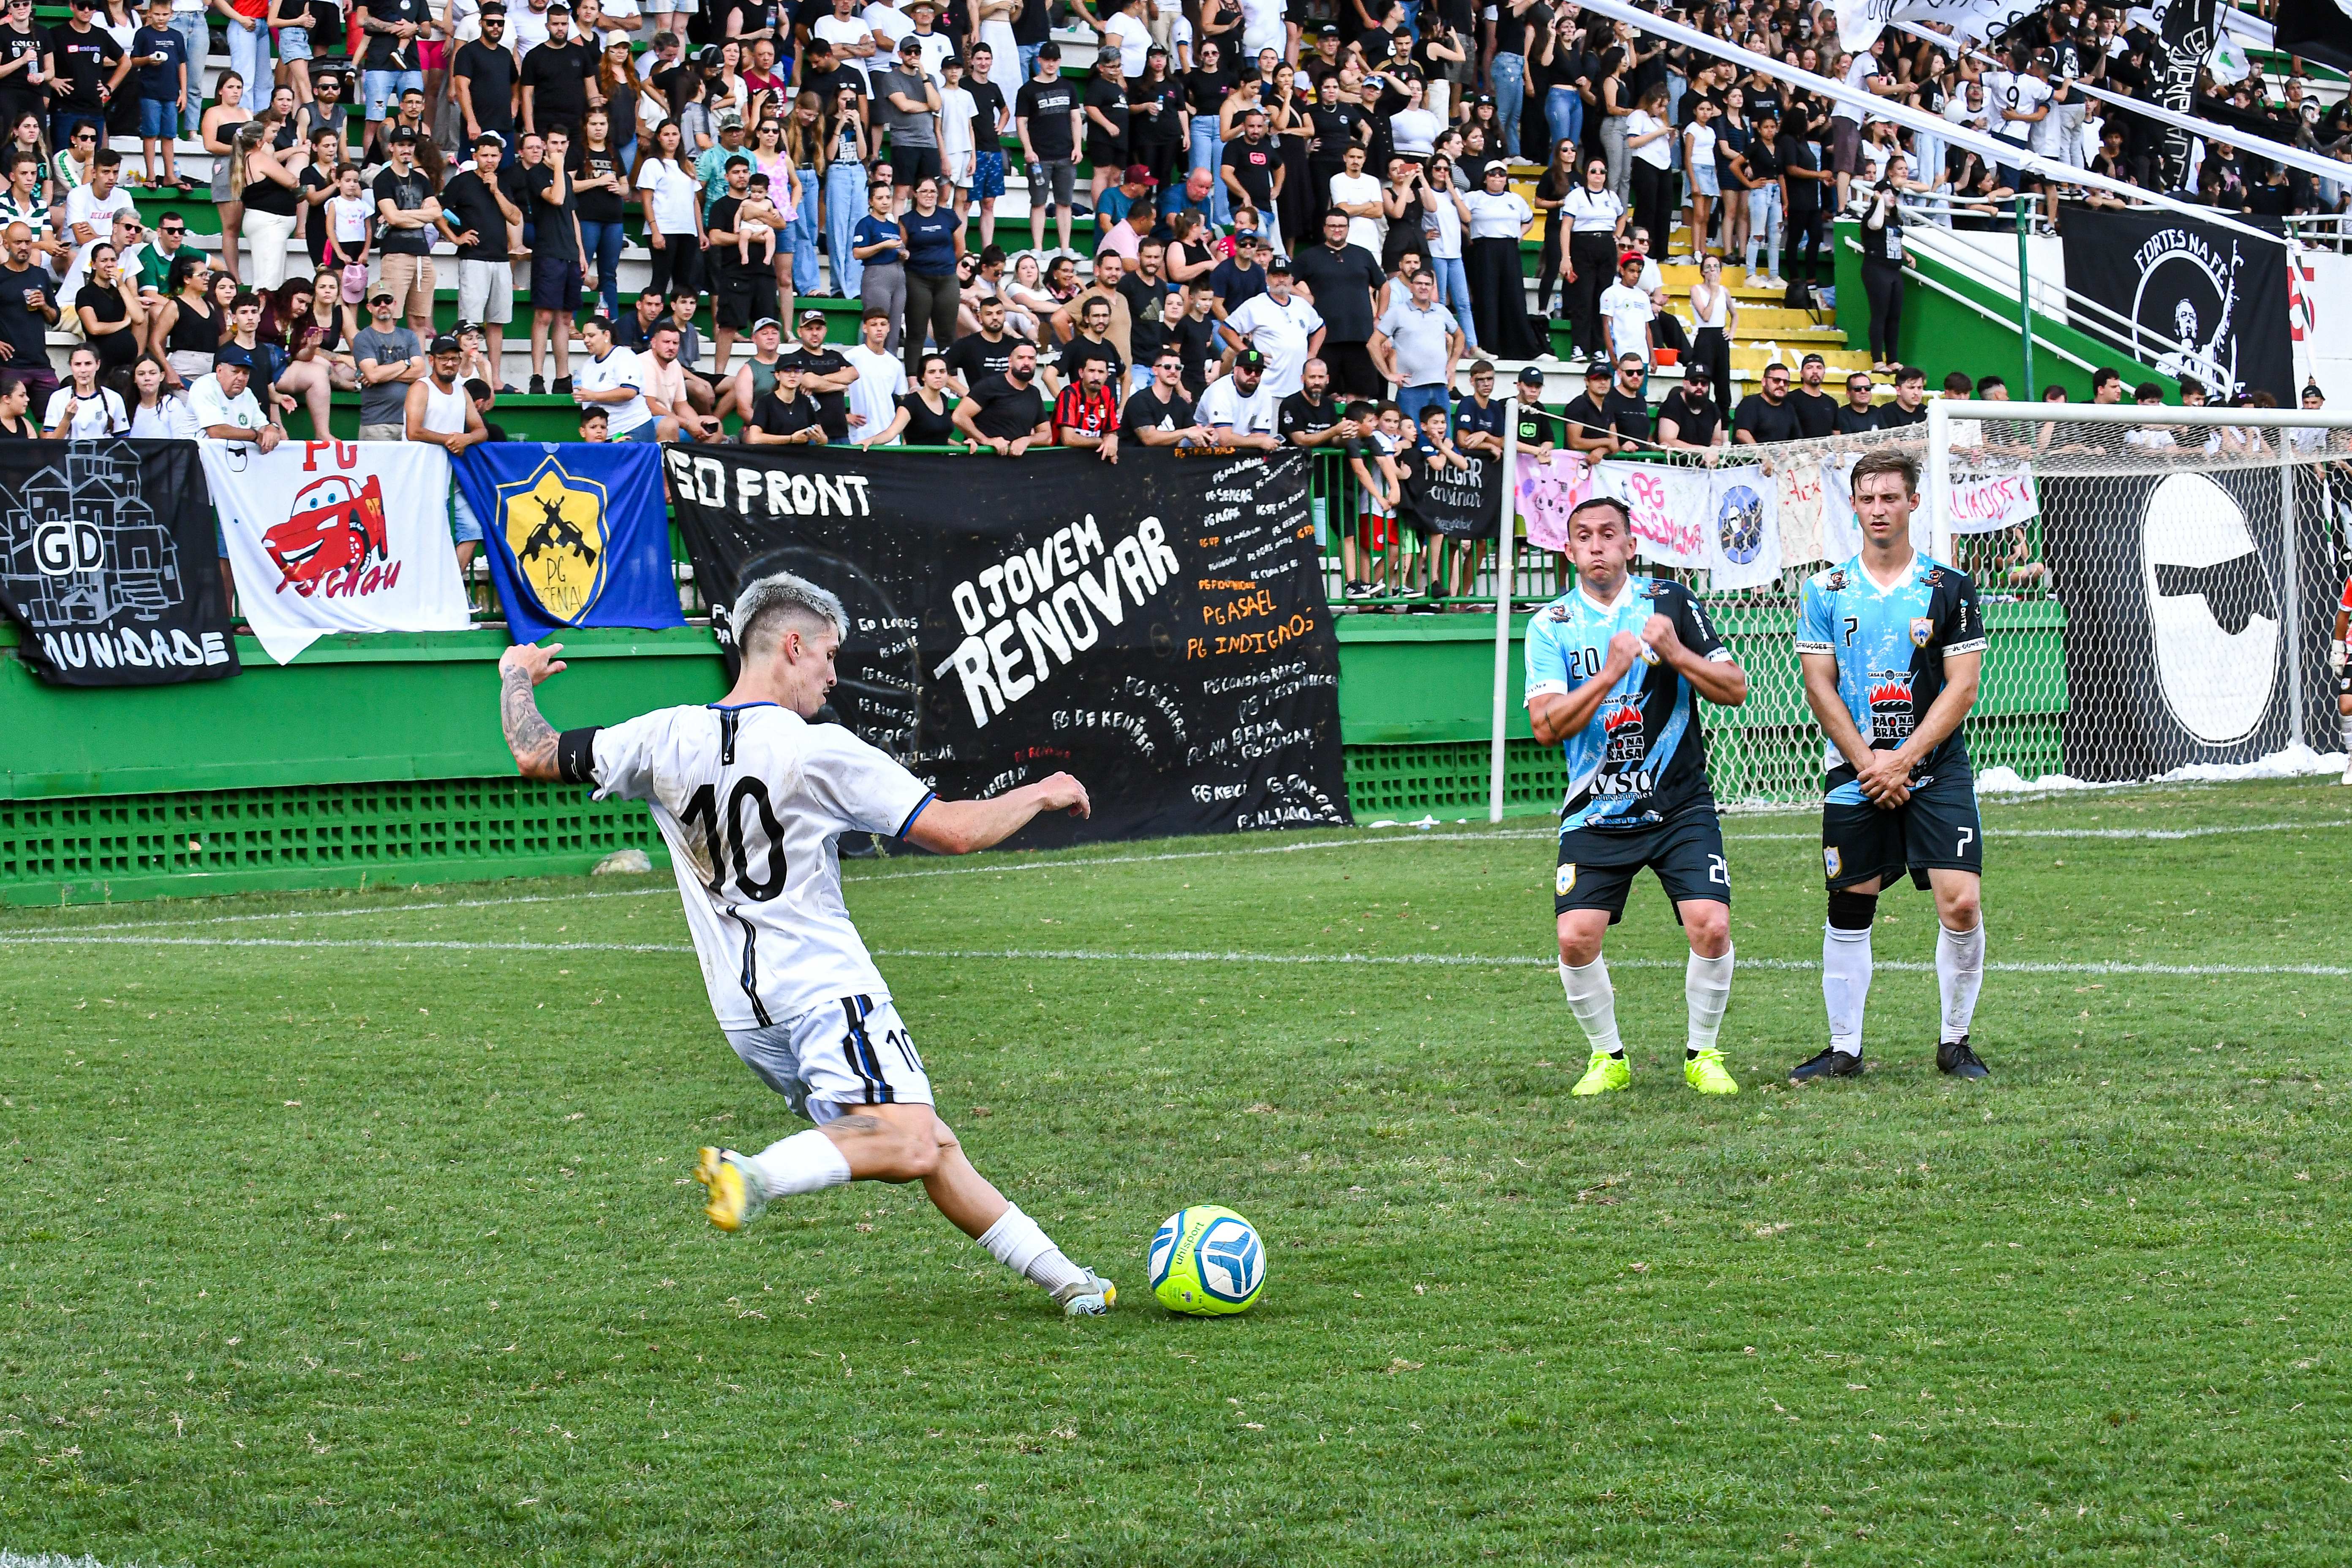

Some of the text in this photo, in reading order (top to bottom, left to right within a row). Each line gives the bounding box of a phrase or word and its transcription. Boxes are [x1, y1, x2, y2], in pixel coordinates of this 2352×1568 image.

[1037, 96, 1070, 109] GUESS
[2006, 86, 2020, 110] 9
[2134, 229, 2186, 274] FORTES
[2189, 233, 2208, 261] NA
[1424, 456, 1482, 488] EGAR
[736, 468, 870, 516] FRONT
[1424, 486, 1481, 508] ensinar
[1632, 472, 1664, 510] PG
[33, 521, 104, 575] GD
[547, 556, 566, 585] PG
[933, 516, 1180, 729] RENOVAR
[1203, 589, 1277, 625] PG ASAEL
[36, 620, 229, 671] MUNIDADE
[1843, 617, 1858, 647] 7
[1187, 637, 1207, 661] PG
[1569, 647, 1601, 680] 20
[1872, 714, 1914, 727] PÃO NA
[1873, 727, 1914, 738] BRASA
[679, 776, 787, 901] 10
[1957, 827, 1973, 857] 7
[1176, 1222, 1204, 1265] uhlsport
